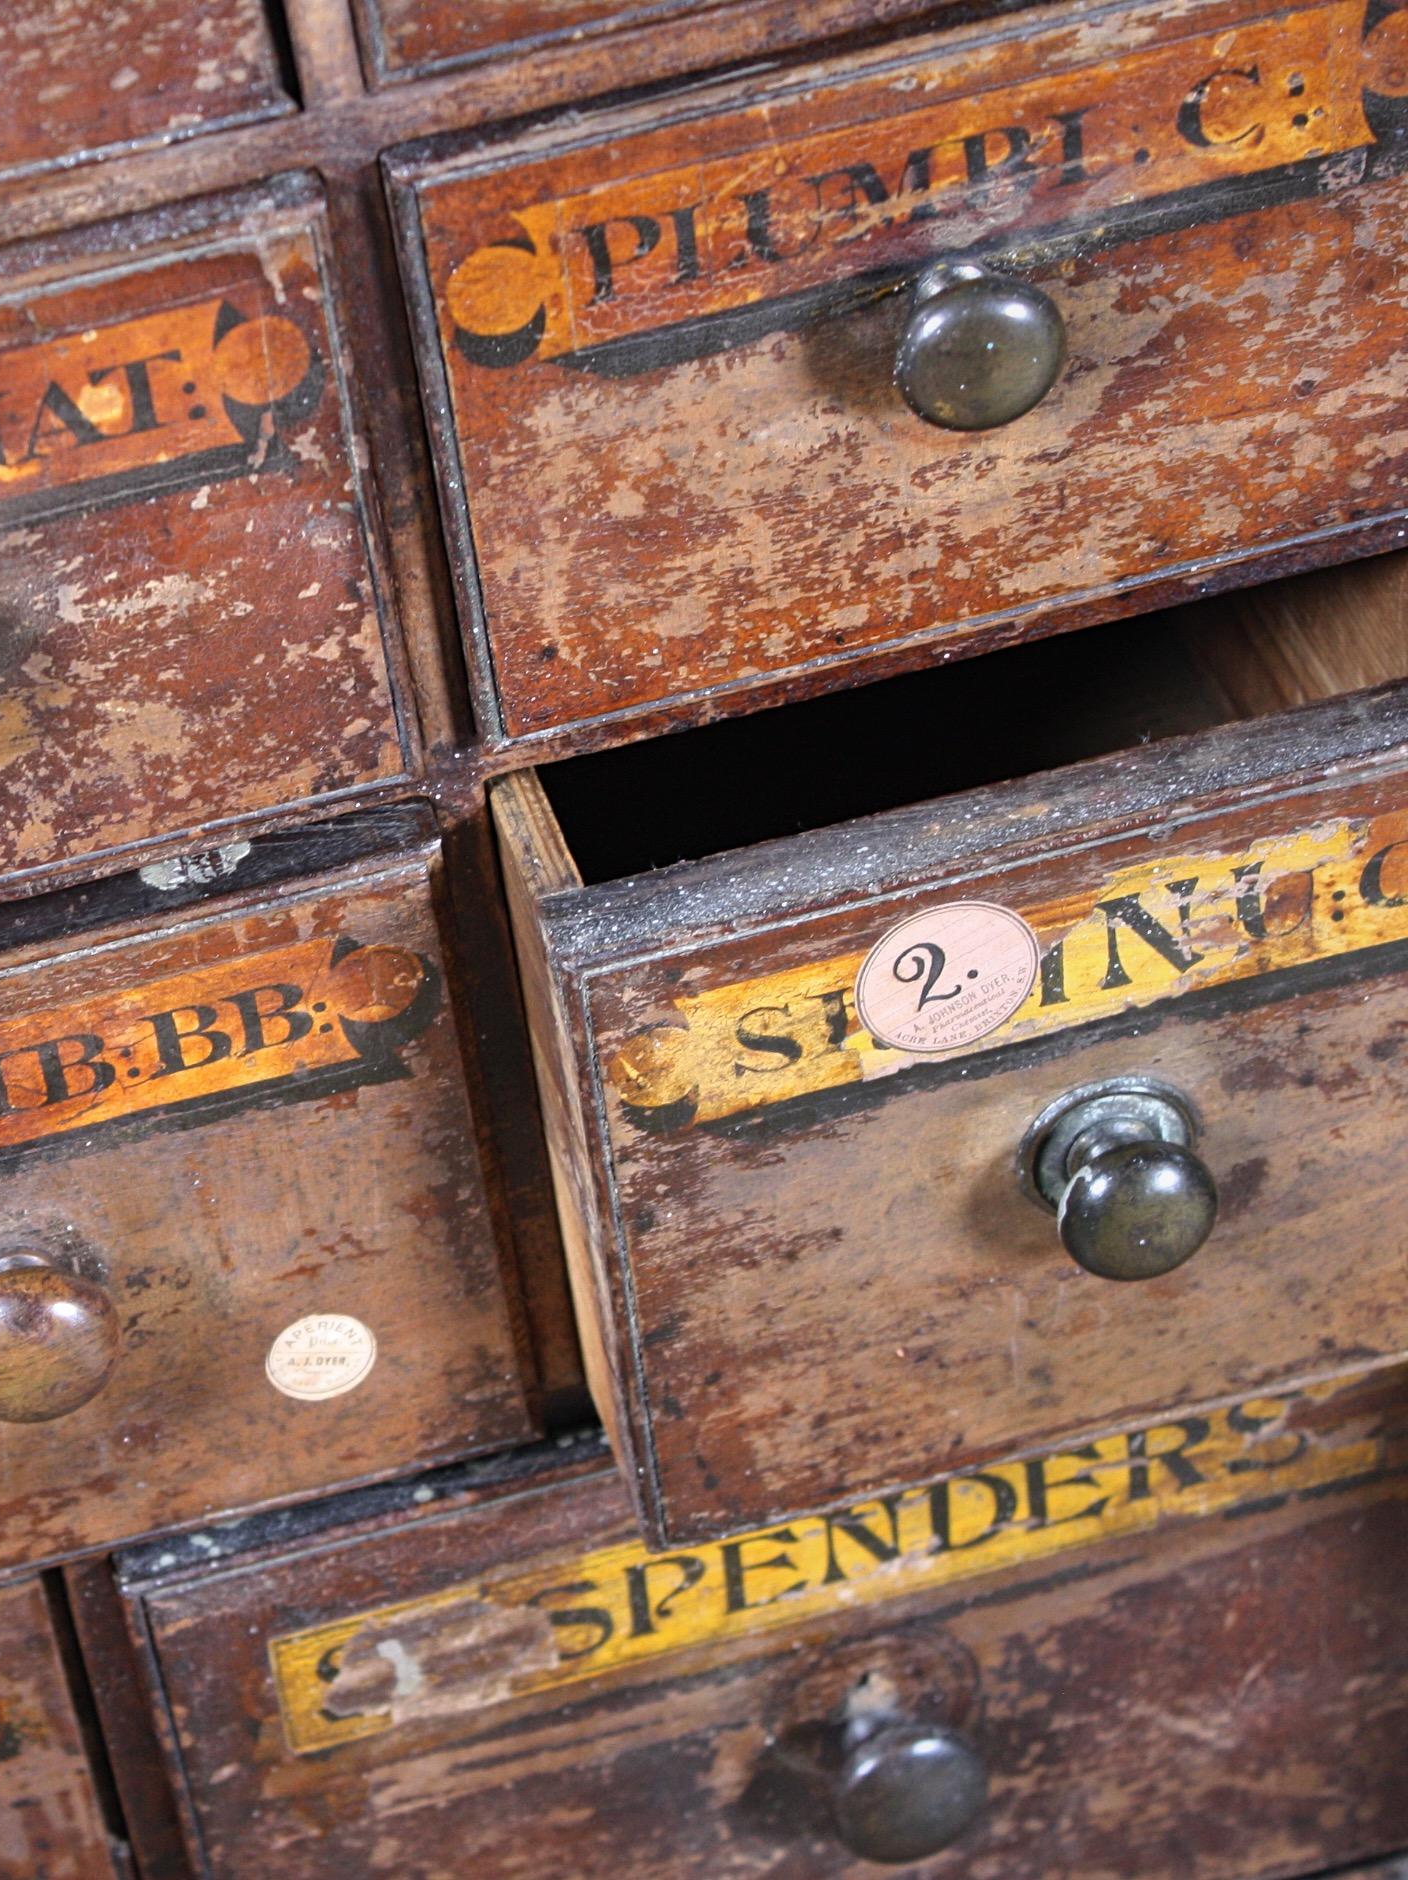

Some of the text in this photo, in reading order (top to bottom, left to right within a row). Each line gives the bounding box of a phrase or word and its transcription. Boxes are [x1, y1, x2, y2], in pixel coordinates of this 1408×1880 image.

[892, 942, 979, 1013] 2.
[928, 992, 978, 1026] JOHNSON
[284, 1320, 364, 1350] APERIENT
